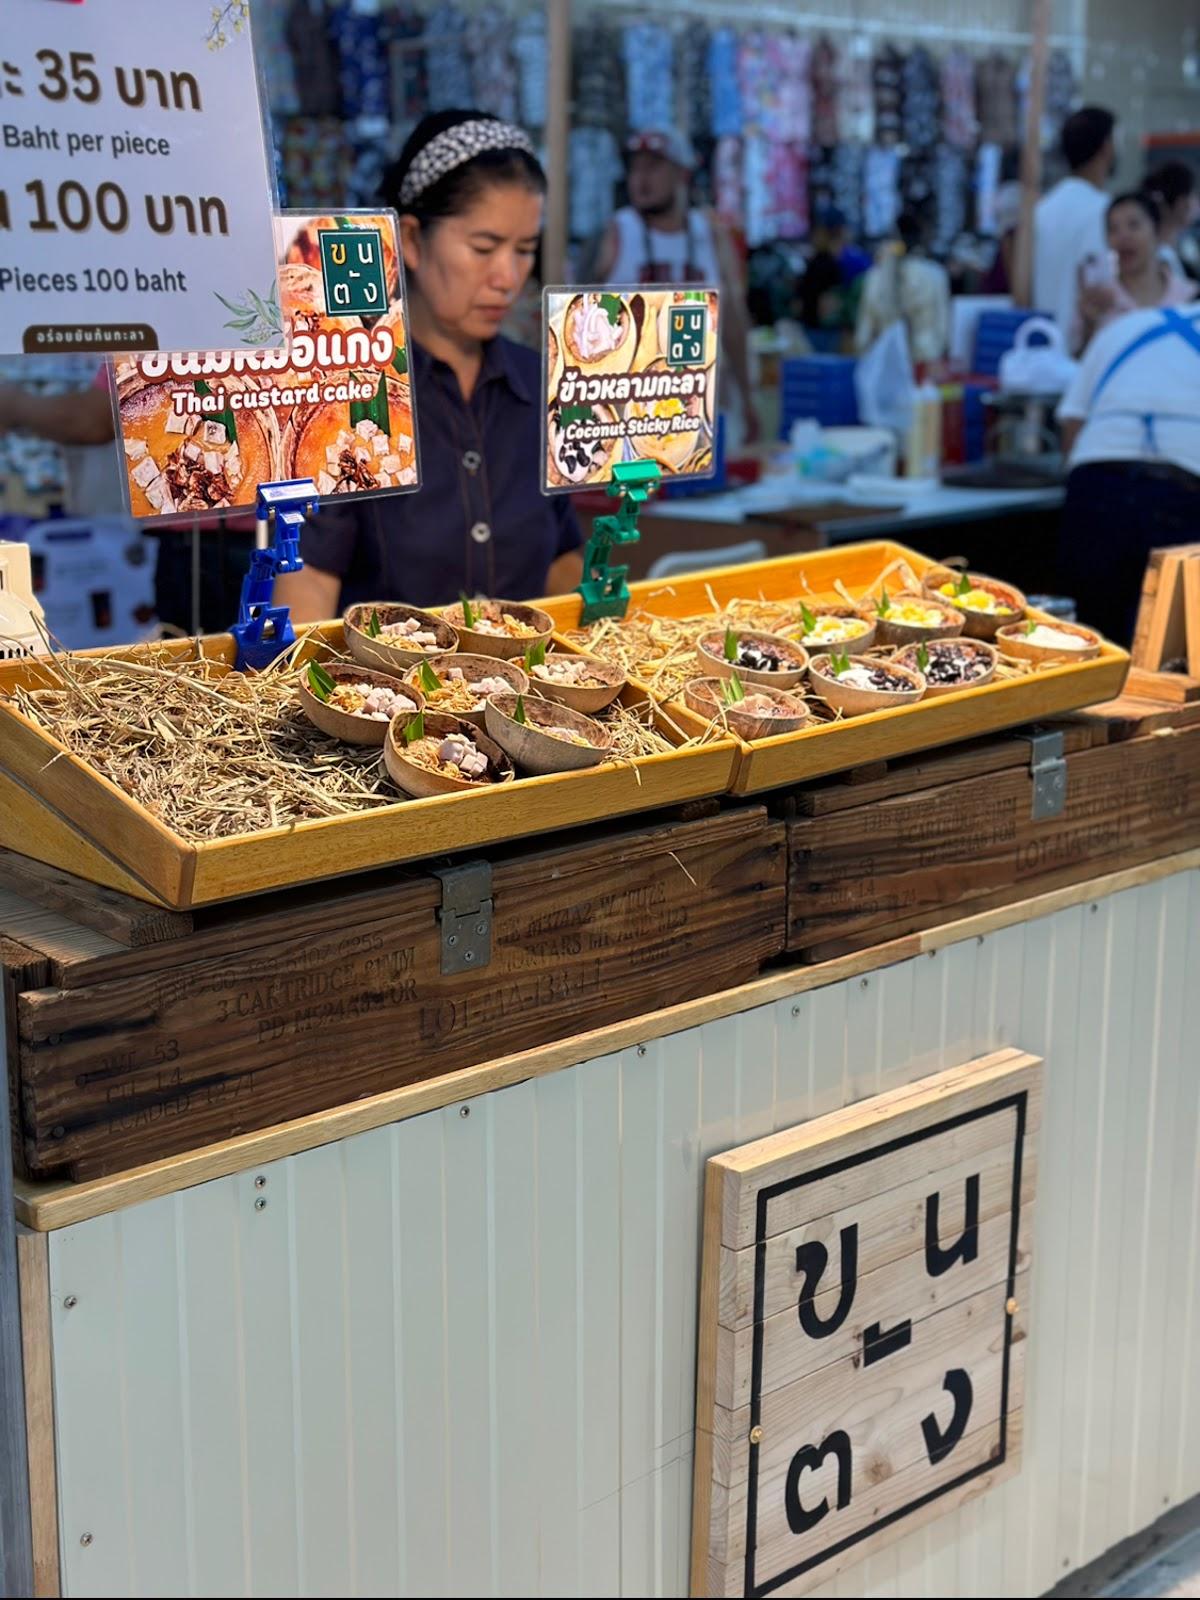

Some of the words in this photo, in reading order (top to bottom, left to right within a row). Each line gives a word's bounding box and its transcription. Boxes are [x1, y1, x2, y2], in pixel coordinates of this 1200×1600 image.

[36, 49, 101, 104] 35
[115, 66, 203, 111] บาท
[3, 125, 60, 151] Baht
[67, 131, 105, 156] per
[111, 131, 170, 158] piece
[25, 179, 130, 234] 100
[145, 194, 230, 236] บาท
[0, 268, 77, 293] Pieces
[83, 268, 129, 292] 100
[135, 268, 188, 293] baht
[140, 331, 394, 378] ขนมหมอแกง
[172, 388, 225, 414] Thai
[230, 384, 320, 410] custard
[323, 380, 373, 402] cake
[560, 371, 706, 403] ข้าวหลามกะลา
[566, 421, 626, 440] Coconut
[627, 418, 671, 437] Sticky
[672, 414, 700, 431] Rice
